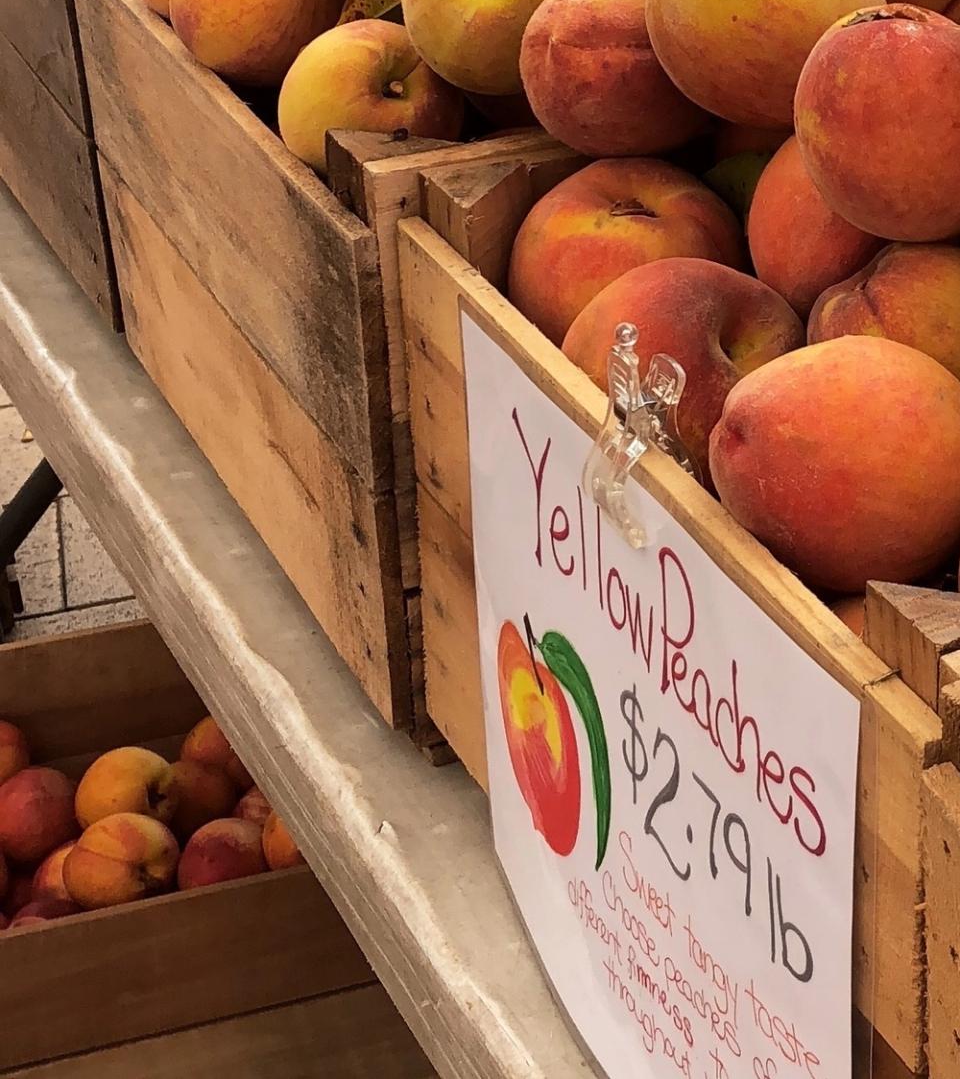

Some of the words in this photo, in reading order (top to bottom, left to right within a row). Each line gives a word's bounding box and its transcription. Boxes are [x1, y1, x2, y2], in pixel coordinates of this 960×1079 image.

[511, 406, 654, 674] Yellow
[658, 546, 826, 857] Peaches
[602, 870, 661, 967] Choose
[619, 683, 752, 917] $2.79
[766, 856, 814, 983] lb
[567, 876, 623, 966] different
[627, 945, 694, 1048] firmness
[602, 955, 692, 1079] throughout
[618, 830, 676, 937] Sweet
[683, 914, 738, 1030] tangy
[744, 977, 821, 1079] taste
